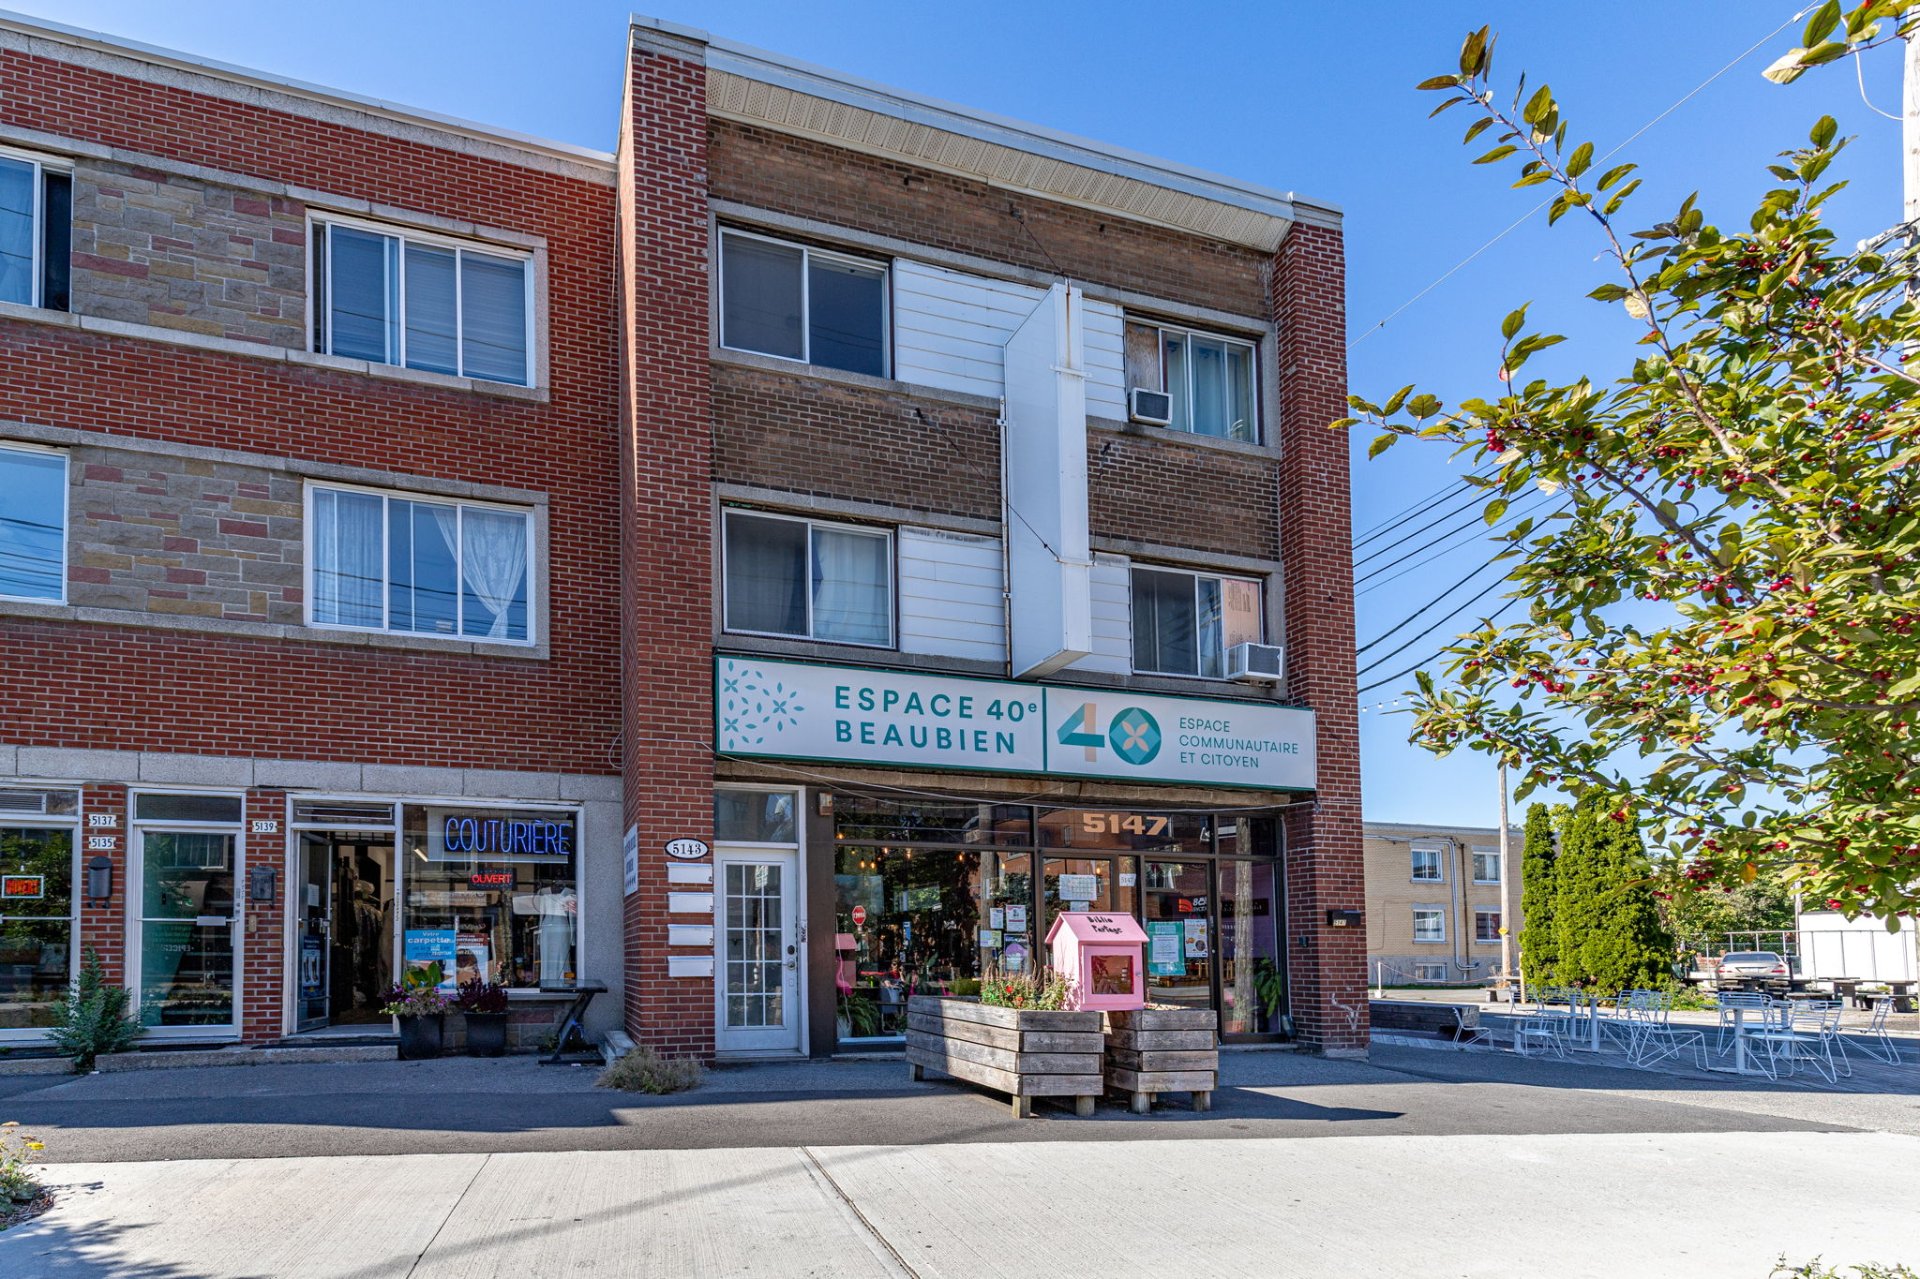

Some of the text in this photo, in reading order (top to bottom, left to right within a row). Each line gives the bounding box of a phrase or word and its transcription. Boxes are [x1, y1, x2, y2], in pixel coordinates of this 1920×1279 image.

[835, 685, 973, 719] ESPACE
[1179, 717, 1231, 733] ESPACE
[836, 719, 1015, 754] BEAUBIEN
[1179, 734, 1299, 754] COMMUNAUTAIRE
[1180, 752, 1259, 768] ET CITOYEN
[92, 816, 113, 826] 5137
[255, 822, 274, 832] 5139
[1083, 812, 1168, 836] 5147
[92, 838, 113, 848] 5135
[445, 817, 570, 855] COUTURIÈRE
[672, 843, 702, 856] 5143
[471, 873, 512, 884] OUVERT
